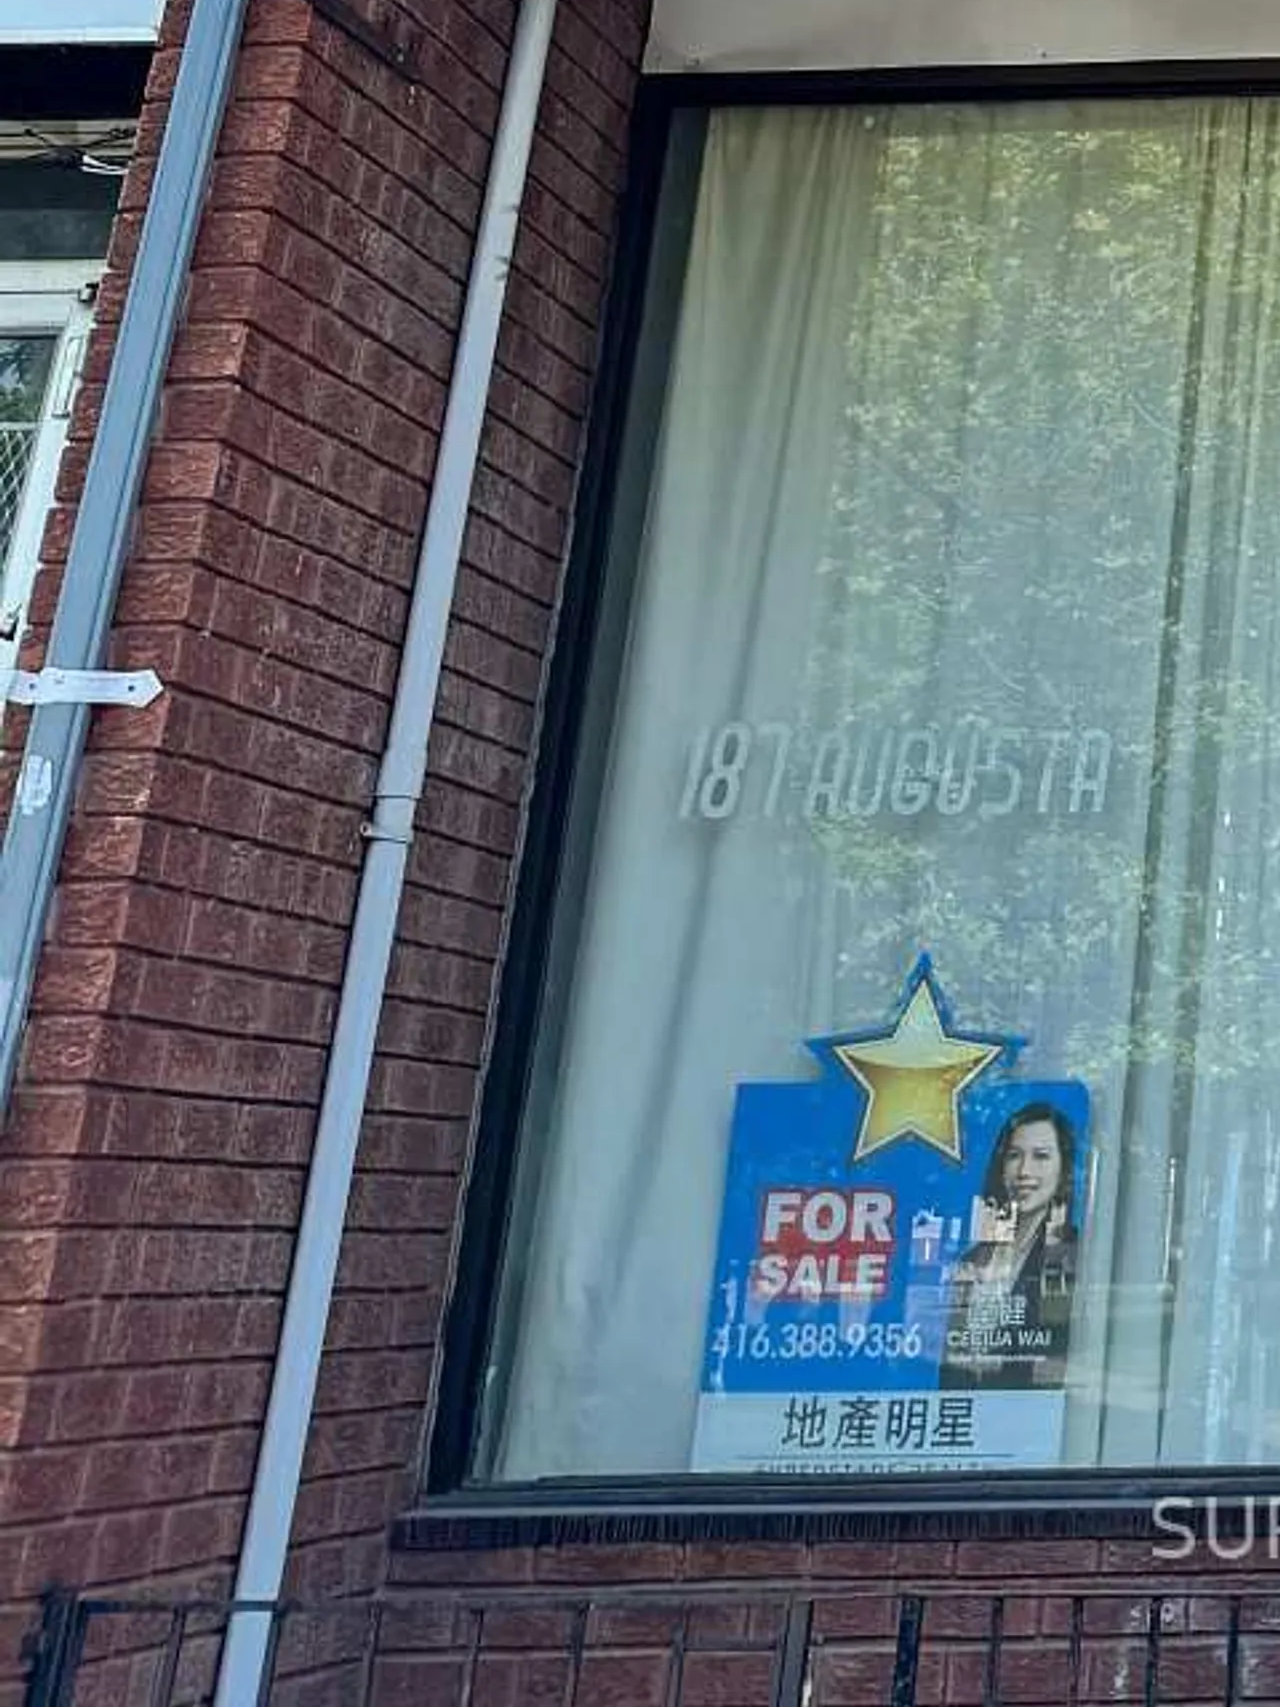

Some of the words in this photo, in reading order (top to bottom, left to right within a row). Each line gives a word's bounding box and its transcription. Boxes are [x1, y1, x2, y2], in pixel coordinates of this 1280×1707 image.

[679, 721, 792, 819] 187
[804, 724, 1113, 818] AUGUSTA
[763, 1191, 893, 1242] FOR
[756, 1253, 888, 1295] SALE
[711, 1322, 922, 1359] 416.388.9356
[1018, 1329, 1052, 1346] WAI
[781, 1395, 975, 1449] 地產明星
